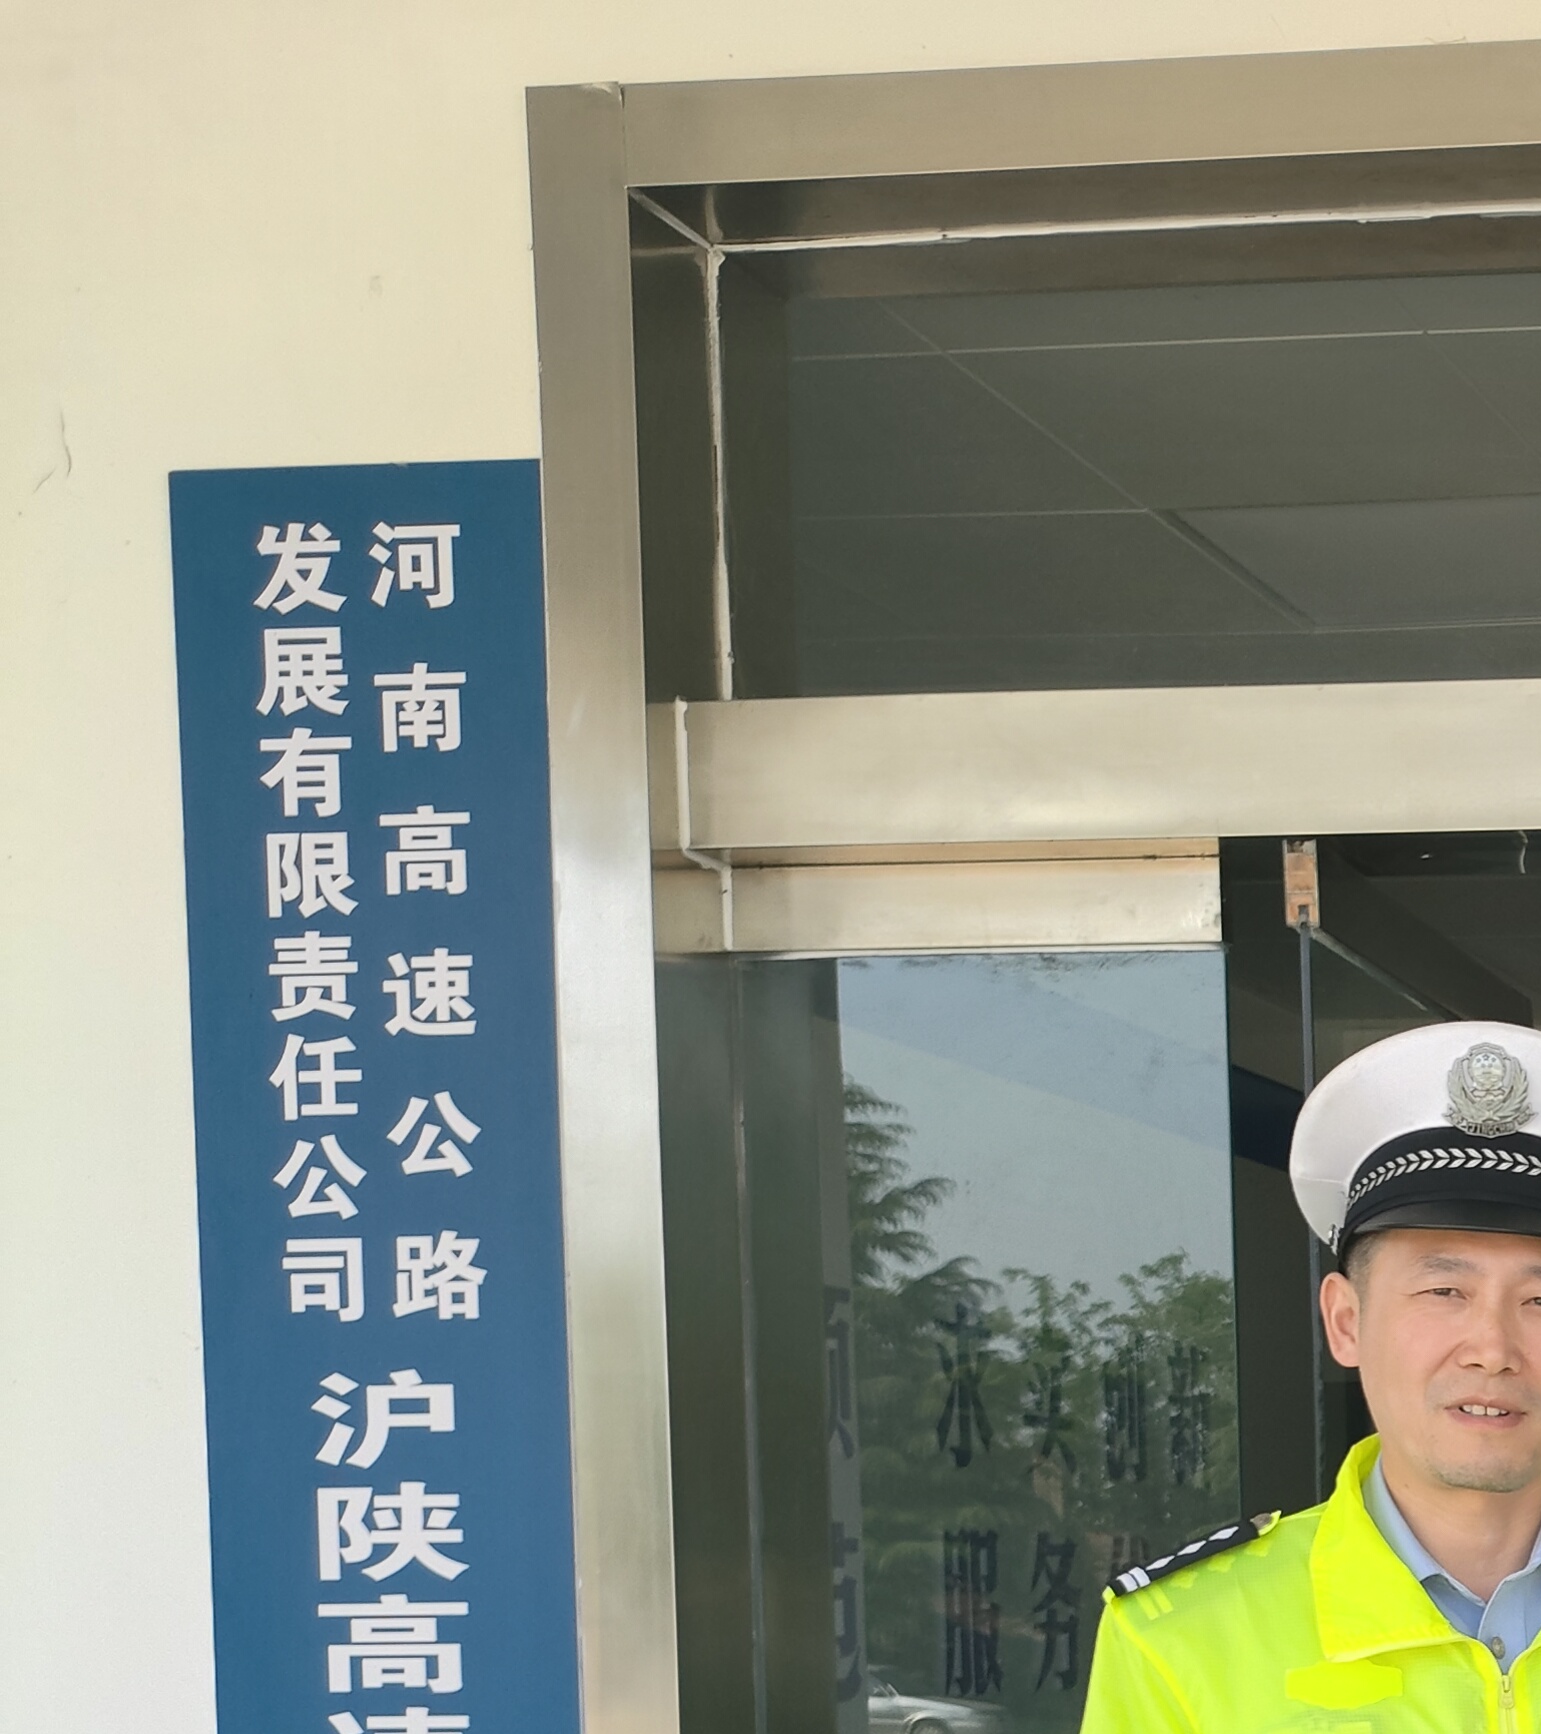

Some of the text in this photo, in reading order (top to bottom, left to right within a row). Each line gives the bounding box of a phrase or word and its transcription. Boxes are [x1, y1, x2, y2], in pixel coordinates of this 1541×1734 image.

[253, 522, 368, 1322] 发展有限责任公司
[369, 521, 488, 1320] 河南高速公路
